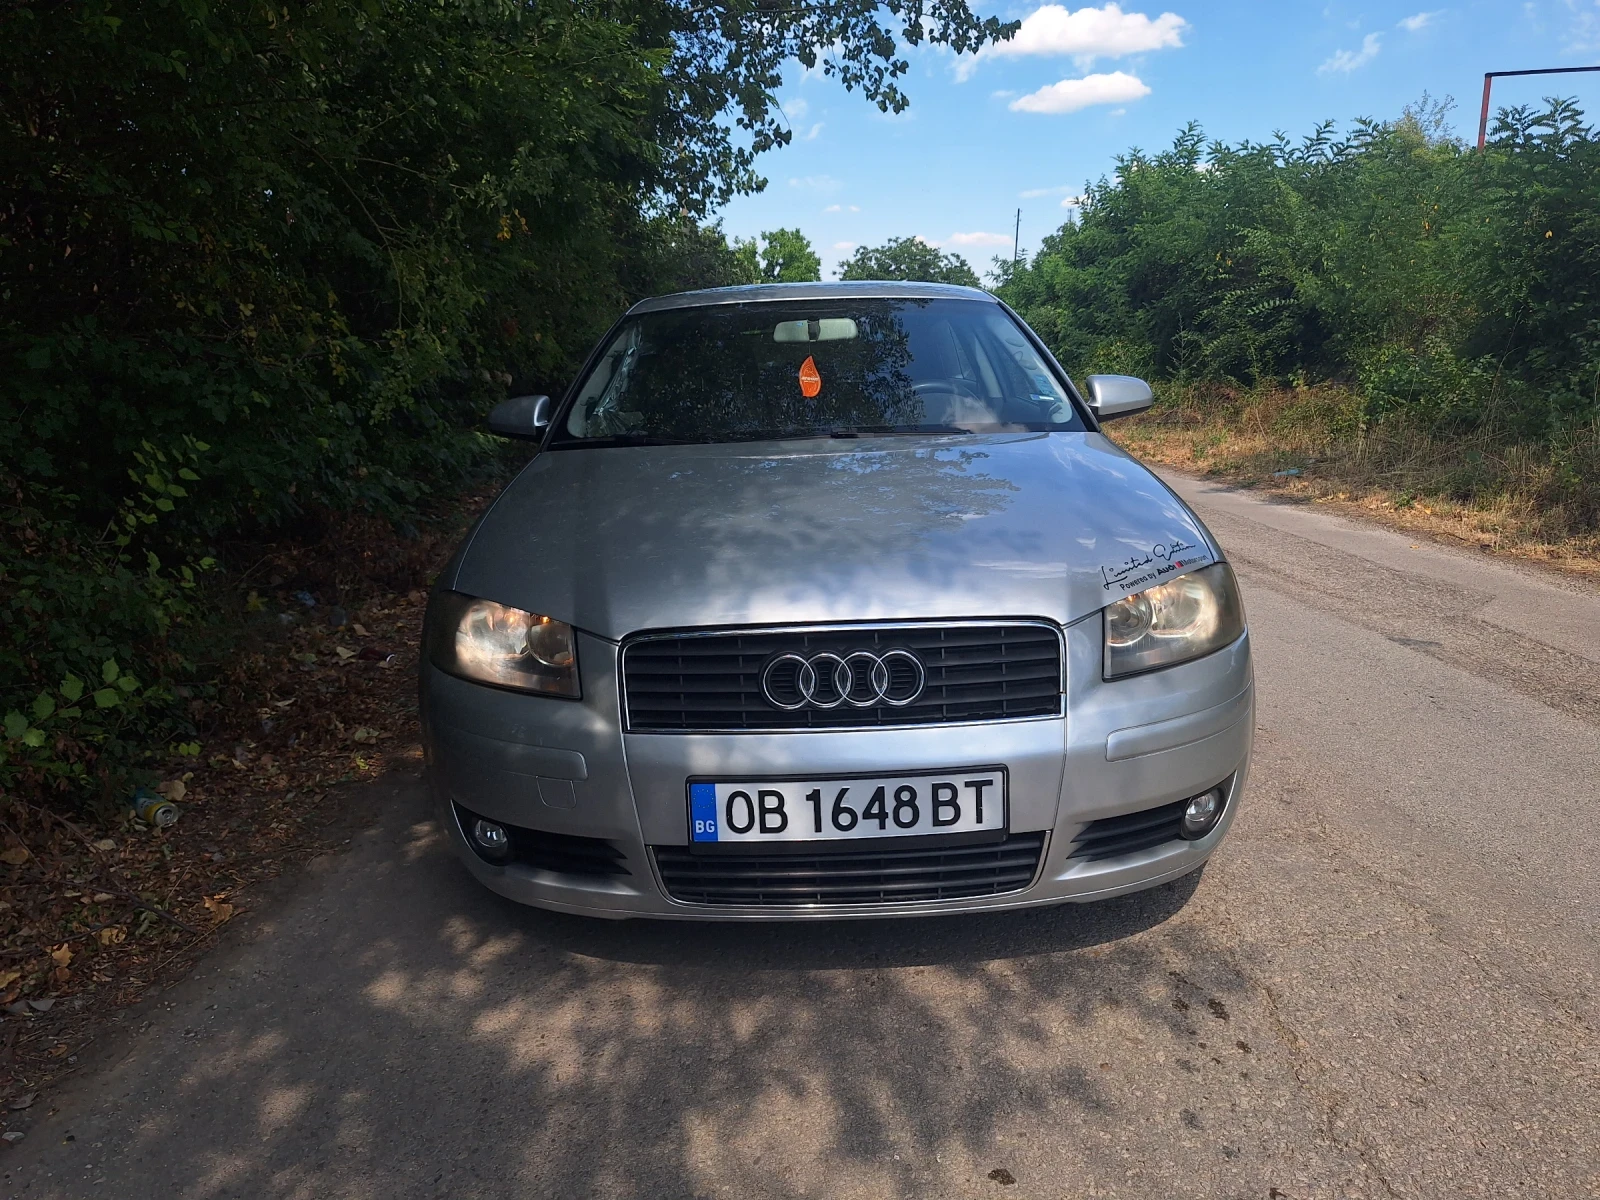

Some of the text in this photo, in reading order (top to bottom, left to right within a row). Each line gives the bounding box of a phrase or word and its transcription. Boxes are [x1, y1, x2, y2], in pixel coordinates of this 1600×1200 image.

[1120, 575, 1148, 591] Powered
[1148, 572, 1157, 581] by
[726, 779, 993, 834] OB 1648 BT
[695, 820, 715, 833] BG
